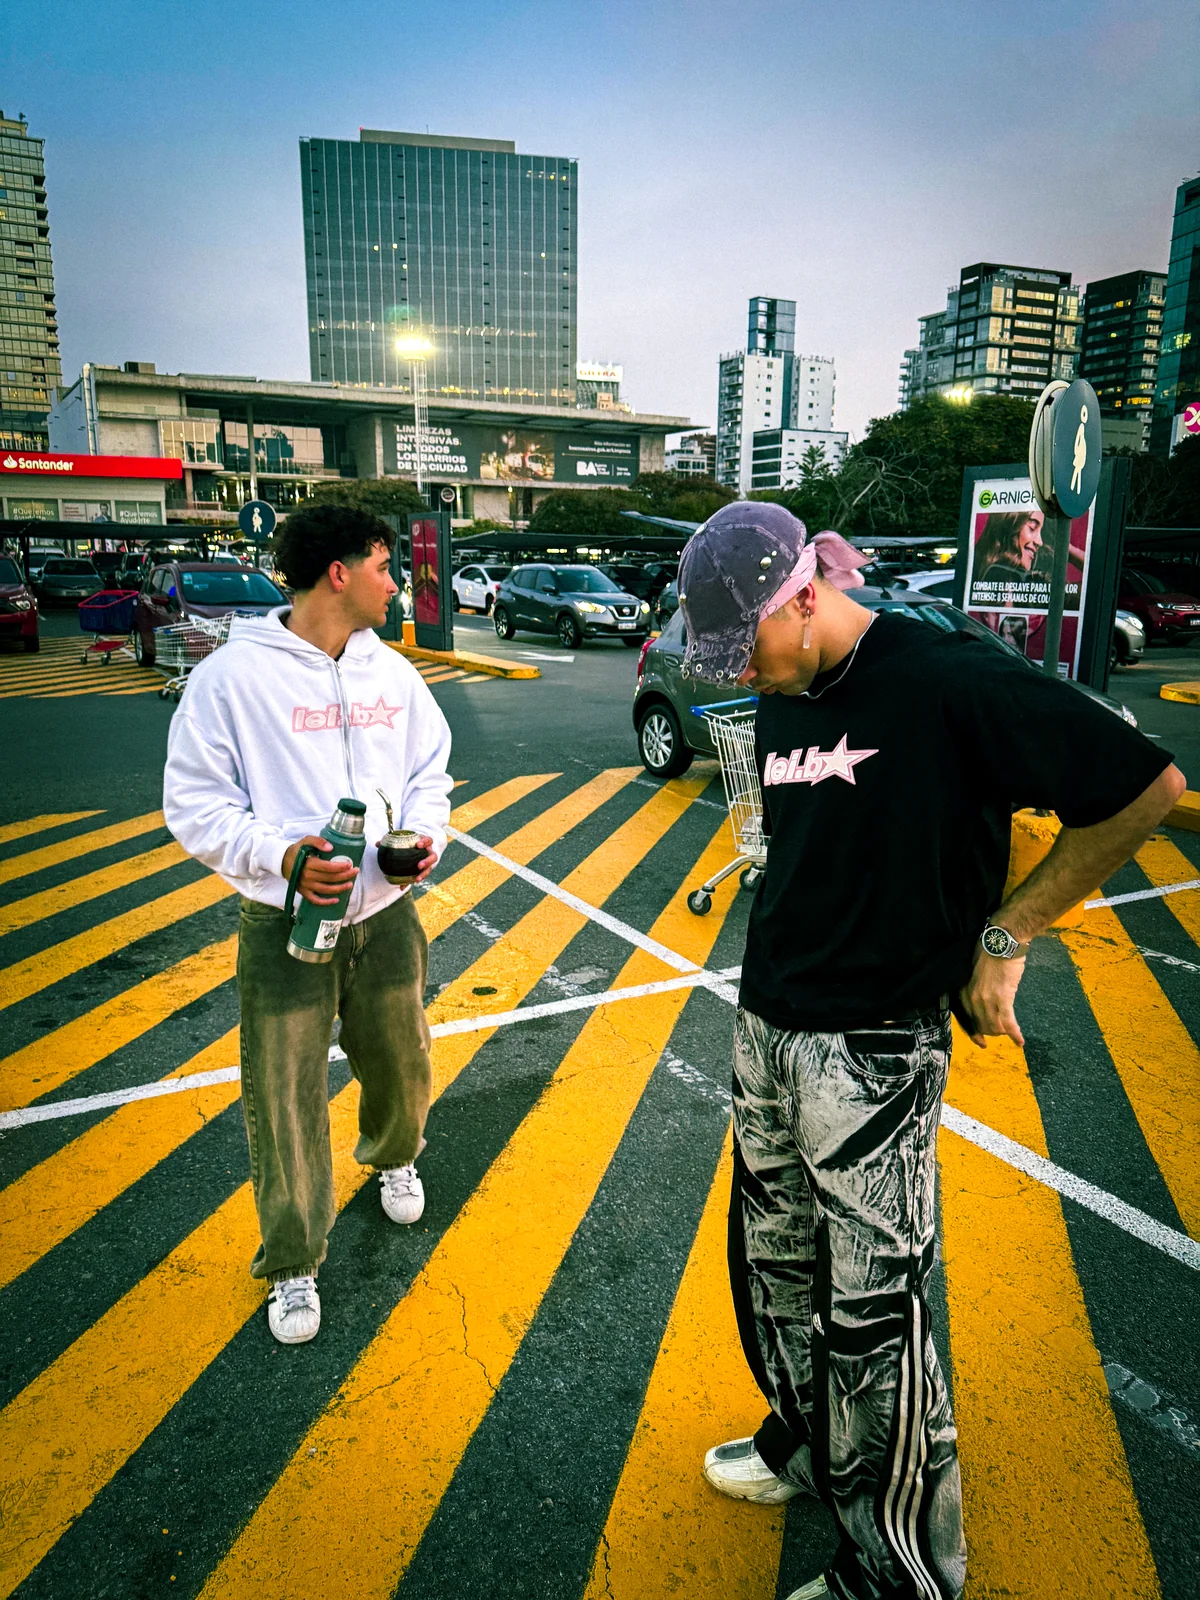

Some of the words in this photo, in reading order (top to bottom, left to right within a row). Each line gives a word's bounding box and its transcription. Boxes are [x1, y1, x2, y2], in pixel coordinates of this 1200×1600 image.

[396, 424, 452, 436] LIMIEZAS
[396, 442, 412, 452] EN
[18, 457, 74, 471] Santander
[420, 453, 466, 464] BARRIOS
[397, 460, 412, 470] DE
[428, 463, 468, 473] CIUDAD
[973, 581, 998, 591] COMBATE
[998, 582, 1005, 591] EL
[1031, 583, 1047, 593] PARA
[1065, 584, 1078, 594] LOR
[1001, 593, 1028, 603] SEMANAS
[1029, 594, 1037, 603] DE
[1037, 595, 1050, 604] COL
